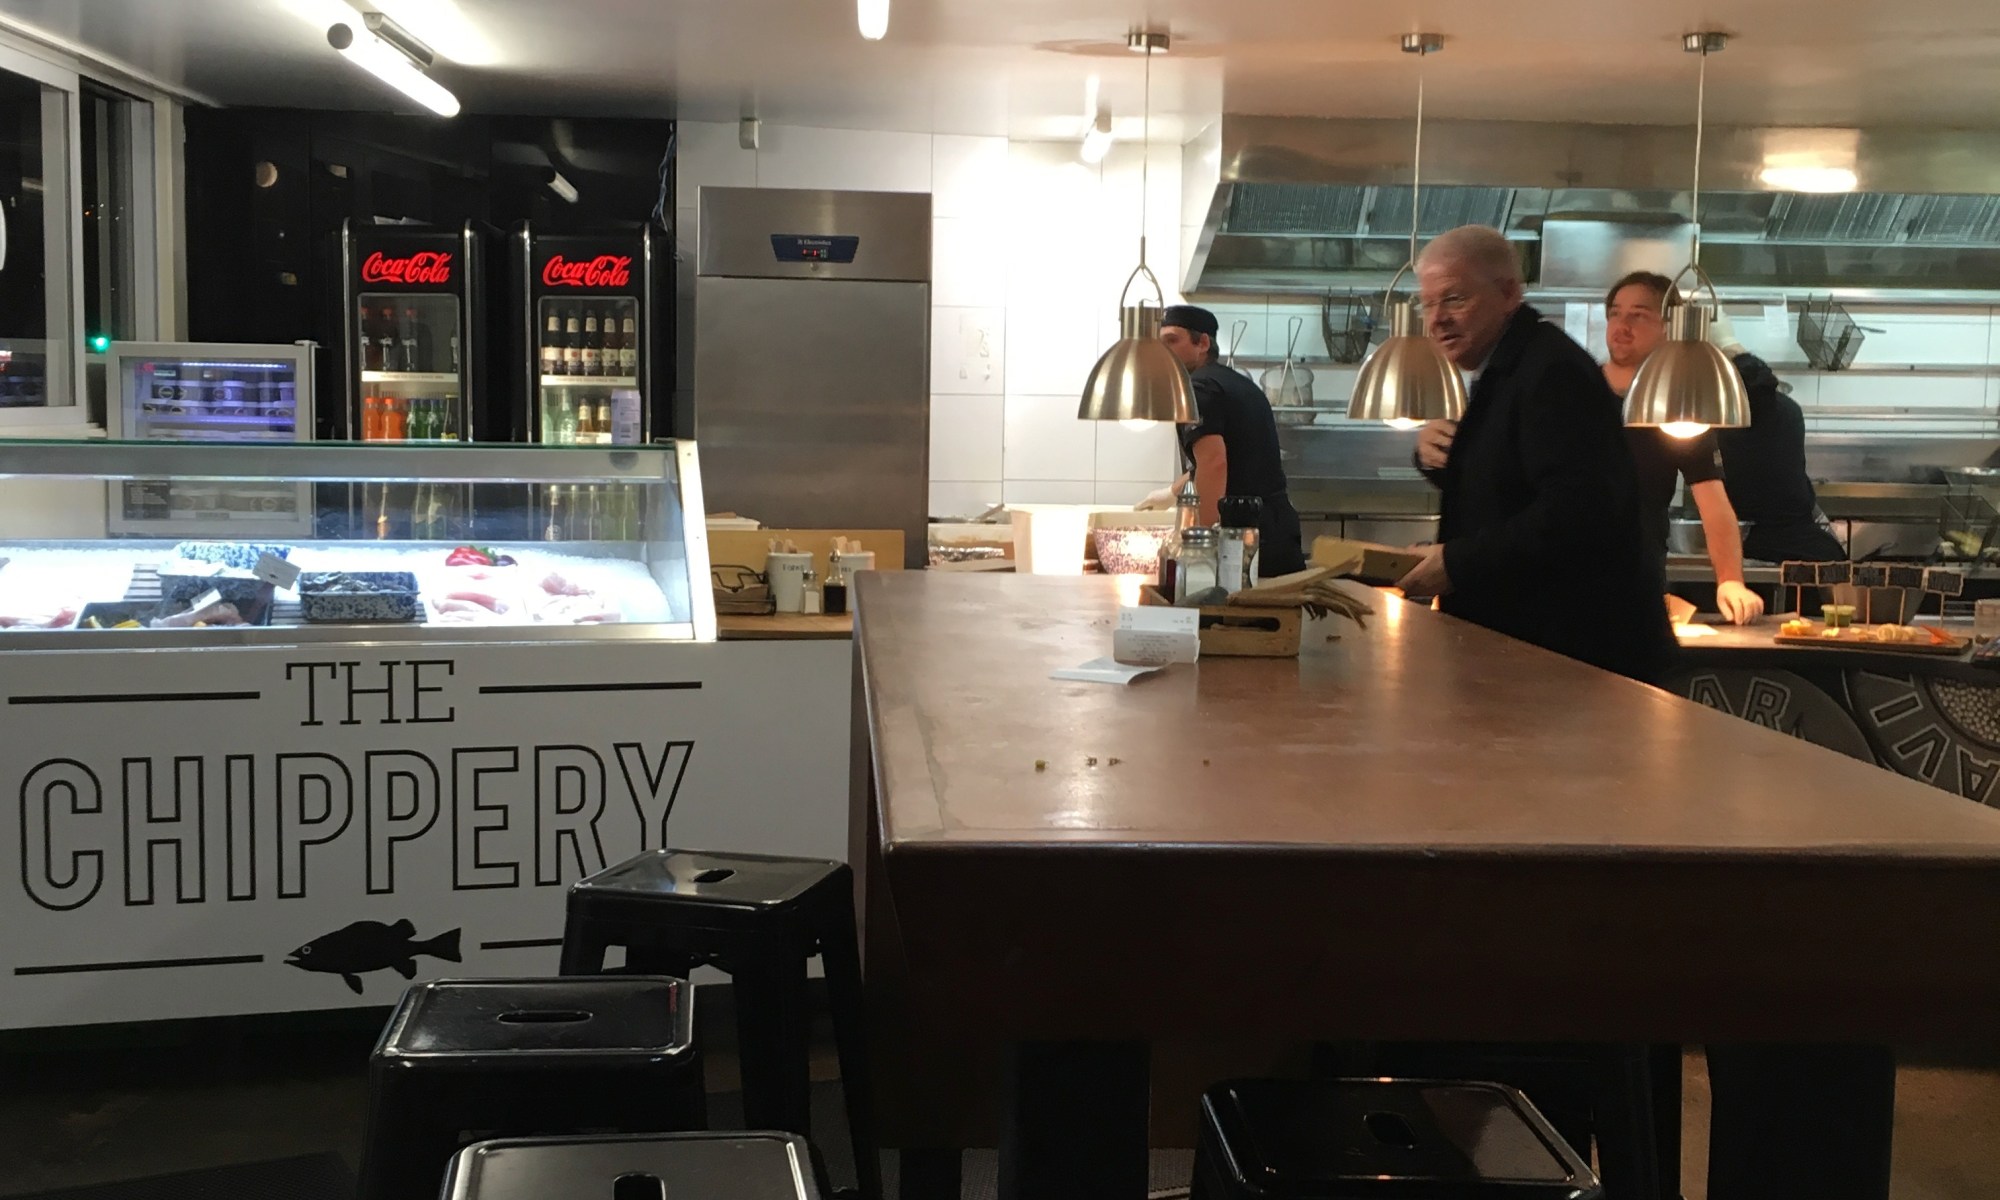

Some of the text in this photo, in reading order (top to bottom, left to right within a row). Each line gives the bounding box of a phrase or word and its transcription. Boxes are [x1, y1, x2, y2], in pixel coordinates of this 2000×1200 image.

[362, 251, 453, 283] Coca-Cola
[542, 255, 633, 287] Coca-Cola
[285, 660, 455, 726] THE
[19, 740, 696, 912] CHIPPERY
